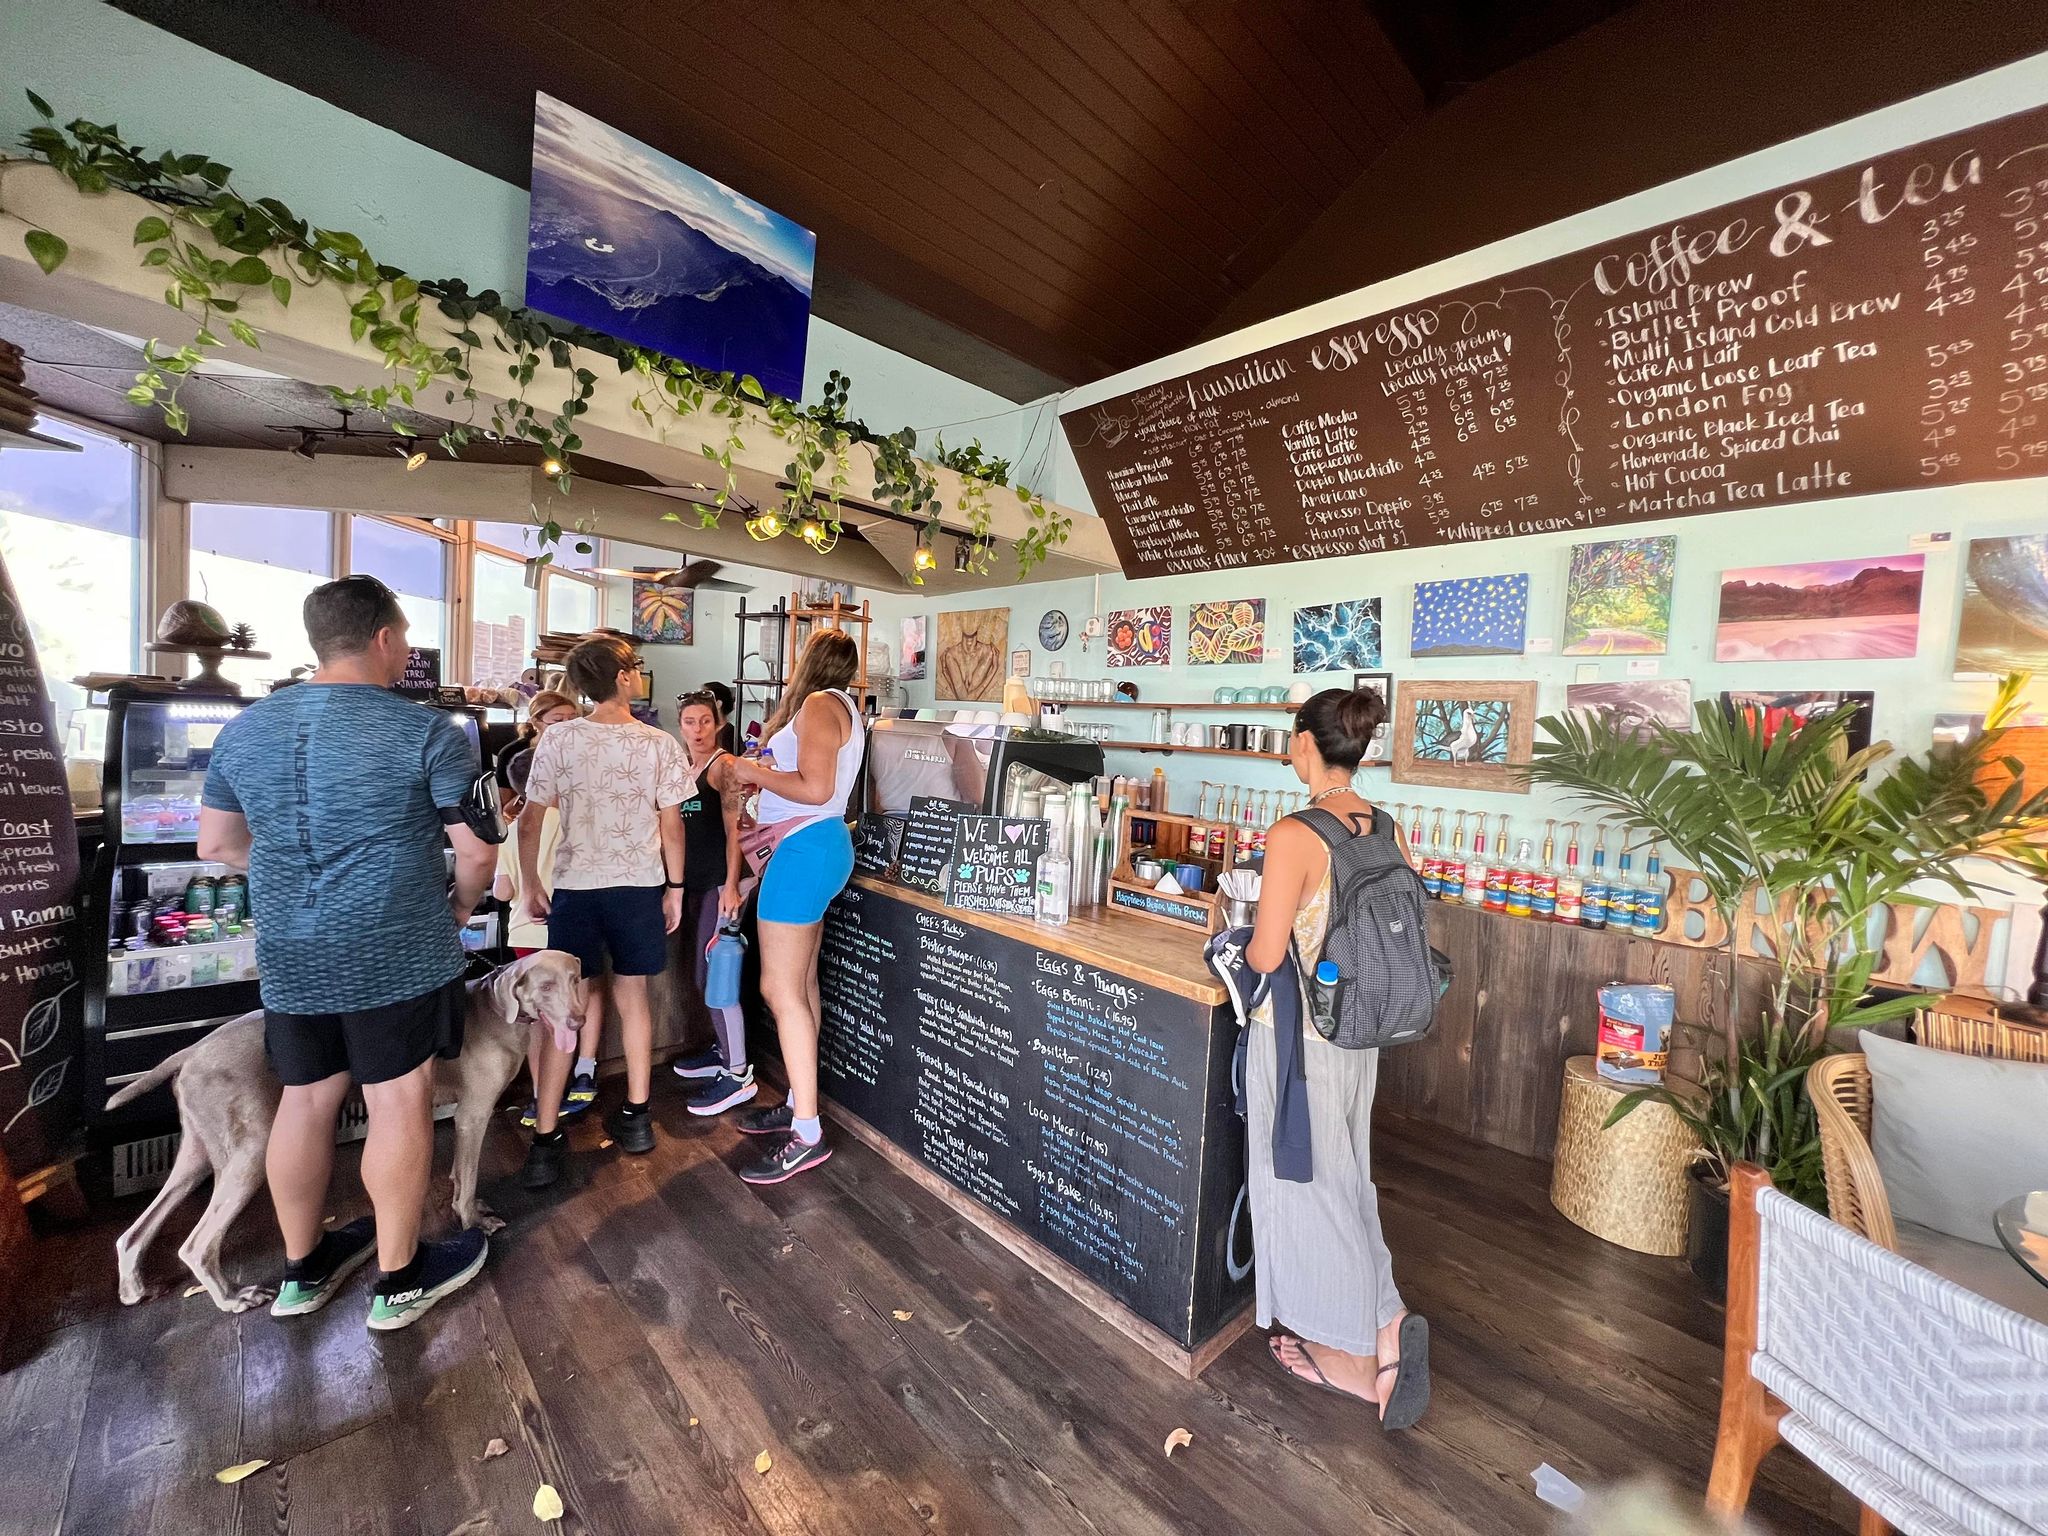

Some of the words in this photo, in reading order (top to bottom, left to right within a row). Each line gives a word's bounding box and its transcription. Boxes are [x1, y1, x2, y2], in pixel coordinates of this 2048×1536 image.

[1594, 218, 1765, 295] Coffee
[1770, 191, 1832, 257] &
[1841, 149, 1981, 224] tea
[1604, 288, 1677, 329] Island
[1688, 273, 1753, 306] Brew
[1717, 270, 1808, 321] Proof
[1612, 336, 1669, 370] Multi
[1685, 316, 1756, 353] Island
[1765, 306, 1818, 335] Cold
[1830, 292, 1901, 323] Brew
[1186, 357, 1296, 410] hawaiian
[1306, 309, 1440, 371] espresso
[1385, 343, 1448, 378] Locally
[1617, 360, 1663, 386] Cafe
[1665, 354, 1693, 376] Au
[1703, 341, 1742, 368] Lait
[1381, 365, 1437, 397] Locally
[1617, 378, 1697, 408] Organic
[1701, 364, 1761, 391] Loose
[1768, 346, 1826, 378] Leaf
[1833, 341, 1877, 363] Tea
[1266, 393, 1300, 410] almond
[1625, 393, 1728, 428] London
[1742, 382, 1792, 406] Fog
[1232, 409, 1252, 422] soy
[1282, 419, 1317, 438] Caffe
[1318, 409, 1358, 429] Mocha
[1622, 422, 1697, 449] Organic
[1704, 413, 1759, 438] Black
[1764, 404, 1814, 428] Iced
[1824, 399, 1865, 421] Tea
[1284, 434, 1320, 451] Vanilla
[1324, 425, 1358, 443] Latte
[1622, 442, 1710, 470] Homemade
[1720, 430, 1785, 459] Spiced
[1792, 424, 1840, 446] Chai
[1289, 446, 1323, 464] Caffe
[1325, 439, 1357, 456] Latte
[1294, 452, 1363, 478] Cappuccino
[1296, 474, 1336, 493] Doppio
[1338, 457, 1404, 485] Macchiato
[1625, 471, 1658, 493] Hot
[1664, 463, 1725, 485] Cocoa
[1628, 487, 1715, 513] Matcha
[1721, 482, 1765, 501] Tea
[1777, 460, 1852, 495] Latte
[1302, 487, 1367, 508] Americano
[1305, 507, 1361, 525] Espresso
[1366, 497, 1411, 516] Doppio
[1160, 516, 1183, 533] Latte
[1310, 523, 1360, 541] Haupia
[1364, 516, 1404, 532] Latte
[1519, 516, 1574, 533] cream
[1172, 530, 1199, 545] Mocha
[1292, 542, 1355, 560] espresso
[1359, 533, 1386, 551] shot
[1214, 551, 1249, 570] flavor
[20, 783, 64, 796] leaves
[964, 818, 988, 842] WE
[19, 860, 60, 876] fresh
[963, 847, 1009, 866] WELCOME
[1014, 848, 1032, 865] ALL
[975, 865, 1015, 886] PUPS
[954, 880, 982, 894] PLEASE
[986, 884, 1006, 897] HAVE
[1009, 884, 1030, 897] THEM
[1583, 887, 1606, 896] Torani
[1610, 892, 1634, 902] Torani
[11, 904, 75, 928] Rama
[1116, 891, 1146, 907] Happiness
[1146, 897, 1165, 912] Begins
[1166, 902, 1182, 916] With
[15, 959, 74, 985] Honey
[1074, 964, 1085, 982] &
[1028, 1099, 1049, 1121] Loco
[944, 1128, 965, 1153] Toast
[1027, 1160, 1046, 1183] Eggs
[1047, 1171, 1055, 1184] &
[387, 1288, 422, 1306] HOKA
